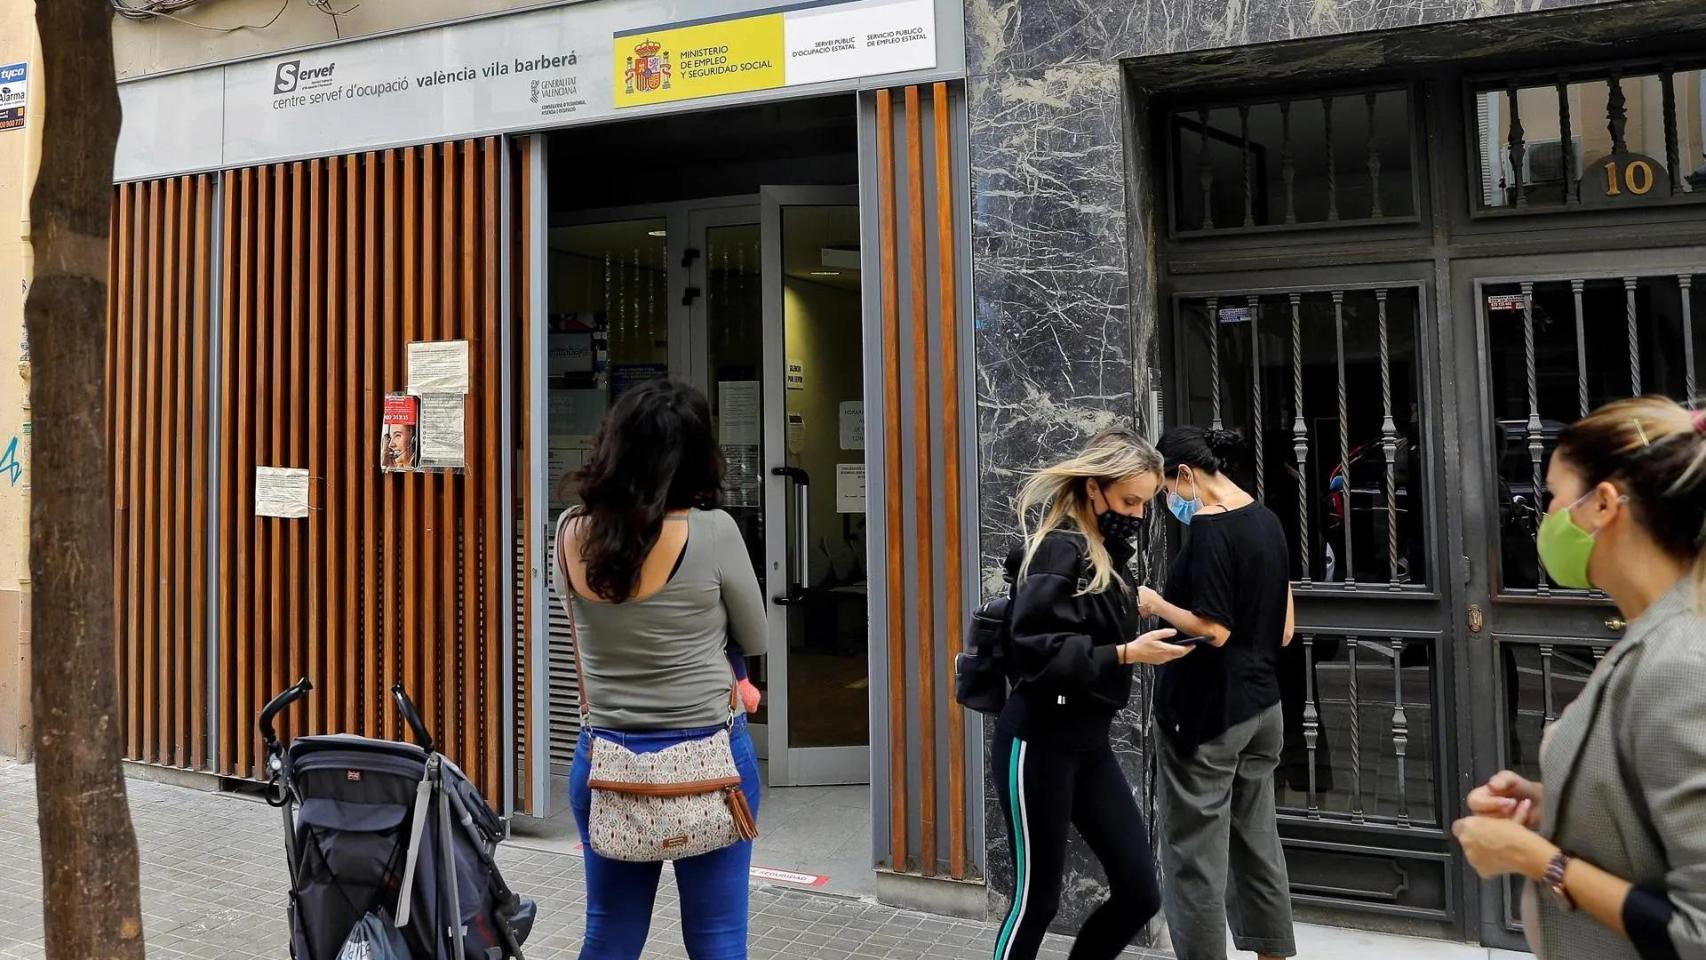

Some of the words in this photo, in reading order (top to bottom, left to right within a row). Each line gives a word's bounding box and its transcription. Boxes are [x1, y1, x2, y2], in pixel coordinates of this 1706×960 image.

[867, 31, 895, 41] SERVICIO
[876, 37, 901, 46] EMPLEO
[902, 34, 927, 43] ESTATAL
[815, 40, 834, 48] SERVEI
[832, 43, 856, 53] ESTATAL
[680, 46, 729, 59] MINISTERIO
[680, 61, 694, 69] DE
[694, 56, 727, 67] EMPLEO
[688, 64, 738, 78] SEGURIDAD
[740, 60, 772, 71] SOCIAL
[1, 68, 24, 80] tyco
[273, 94, 306, 110] centre
[309, 85, 342, 105] servef
[345, 76, 409, 98] d'ocupació
[416, 66, 476, 88] valència
[482, 61, 509, 78] vila
[514, 50, 577, 73] barberá
[274, 61, 336, 93] Servef
[1604, 161, 1653, 196] 10
